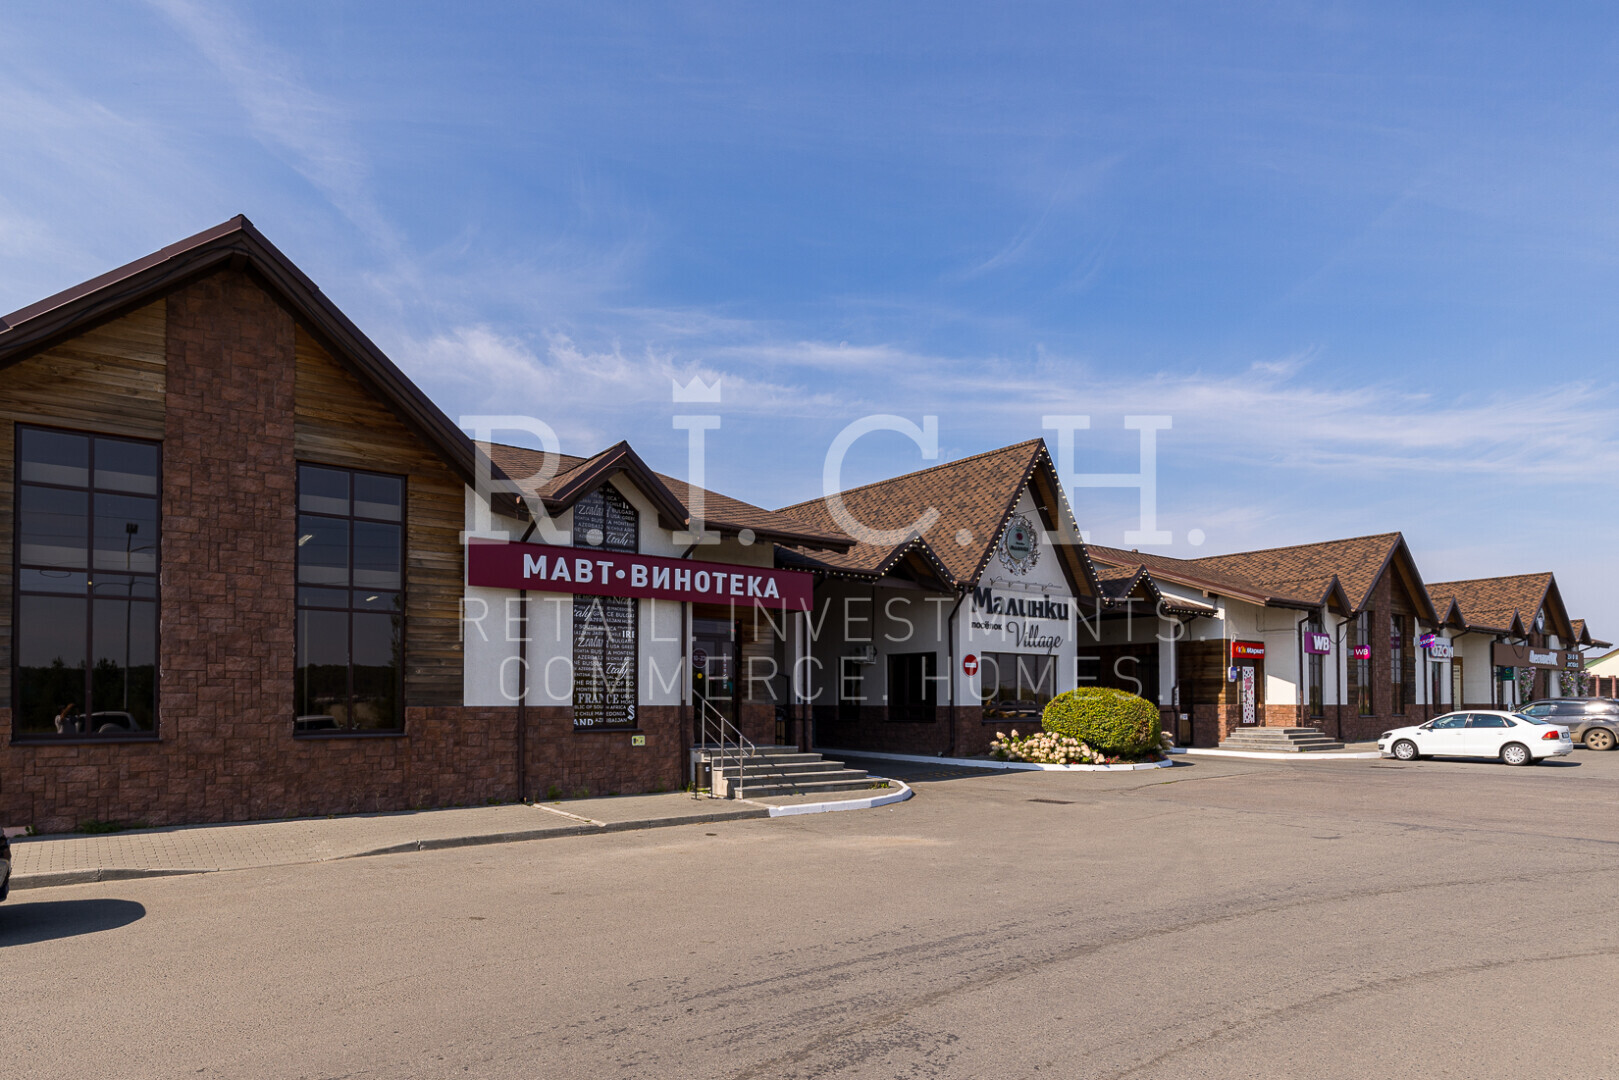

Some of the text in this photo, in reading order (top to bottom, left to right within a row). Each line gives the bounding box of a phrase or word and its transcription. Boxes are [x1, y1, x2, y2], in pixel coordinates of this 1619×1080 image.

[972, 586, 1070, 620] Малинки
[1006, 621, 1064, 656] Village
[1314, 635, 1330, 651] WB
